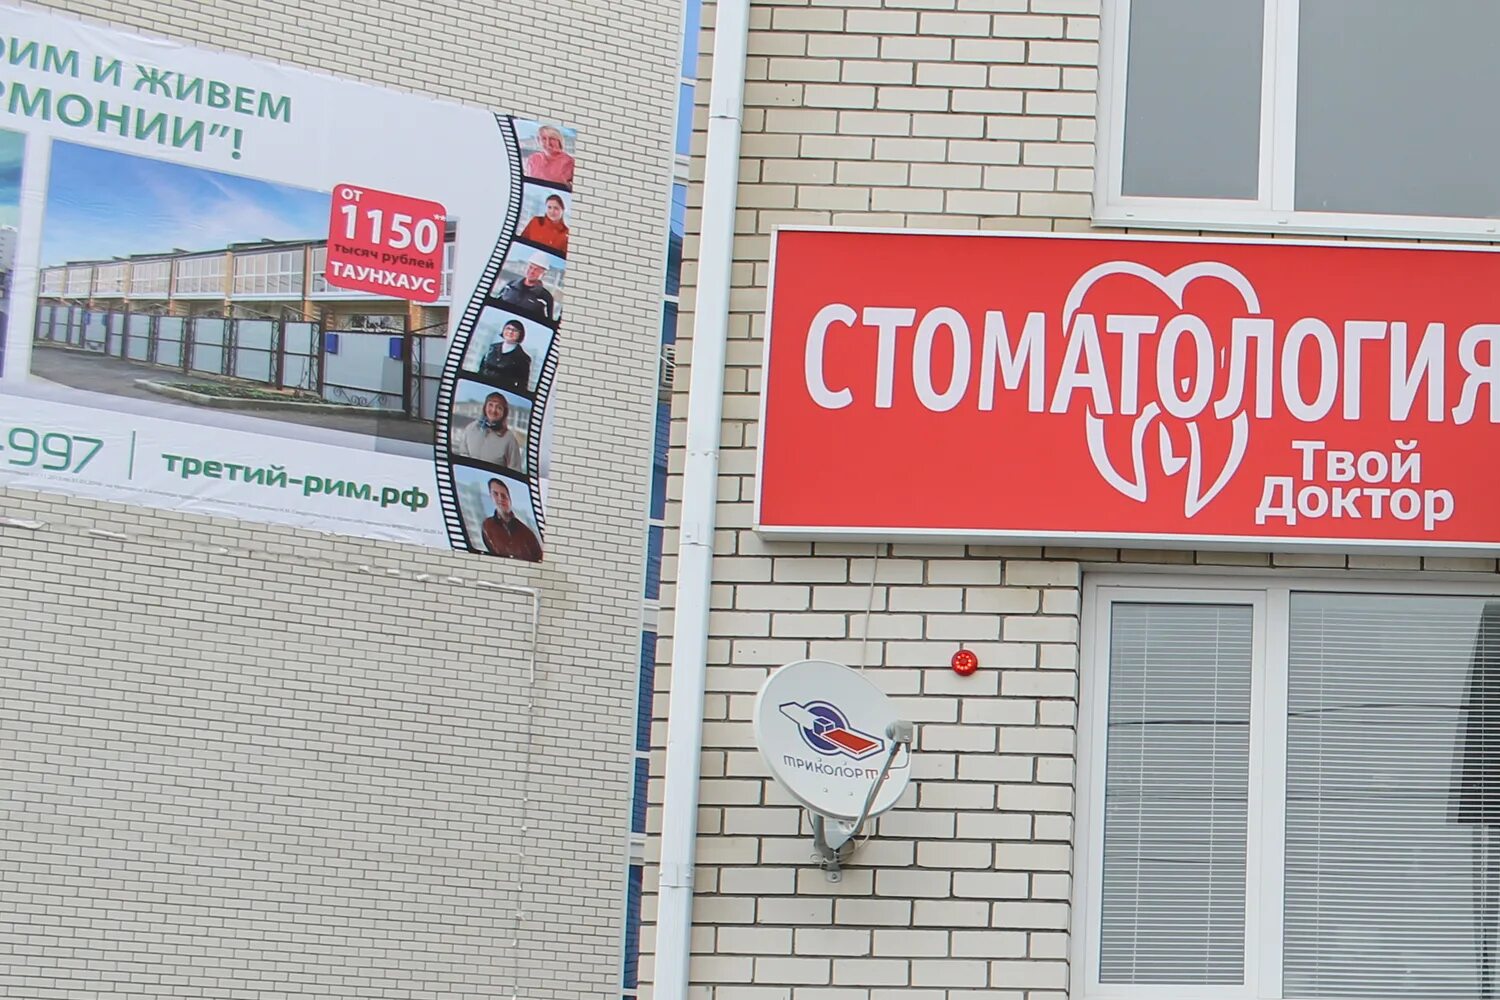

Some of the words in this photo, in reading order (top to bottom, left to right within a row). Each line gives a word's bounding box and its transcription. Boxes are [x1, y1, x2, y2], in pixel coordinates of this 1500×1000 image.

[0, 35, 80, 79] ИМ
[93, 55, 123, 88] И
[133, 63, 292, 124] ЖИВЕМ
[0, 80, 244, 161] МОНИИ"!
[330, 260, 436, 294] ТАУНХАУС
[334, 243, 379, 259] тысяч
[381, 252, 435, 270] рублей
[161, 453, 430, 512] третий-рим.рф
[1291, 438, 1422, 484] Твой
[1255, 475, 1455, 532] Доктор
